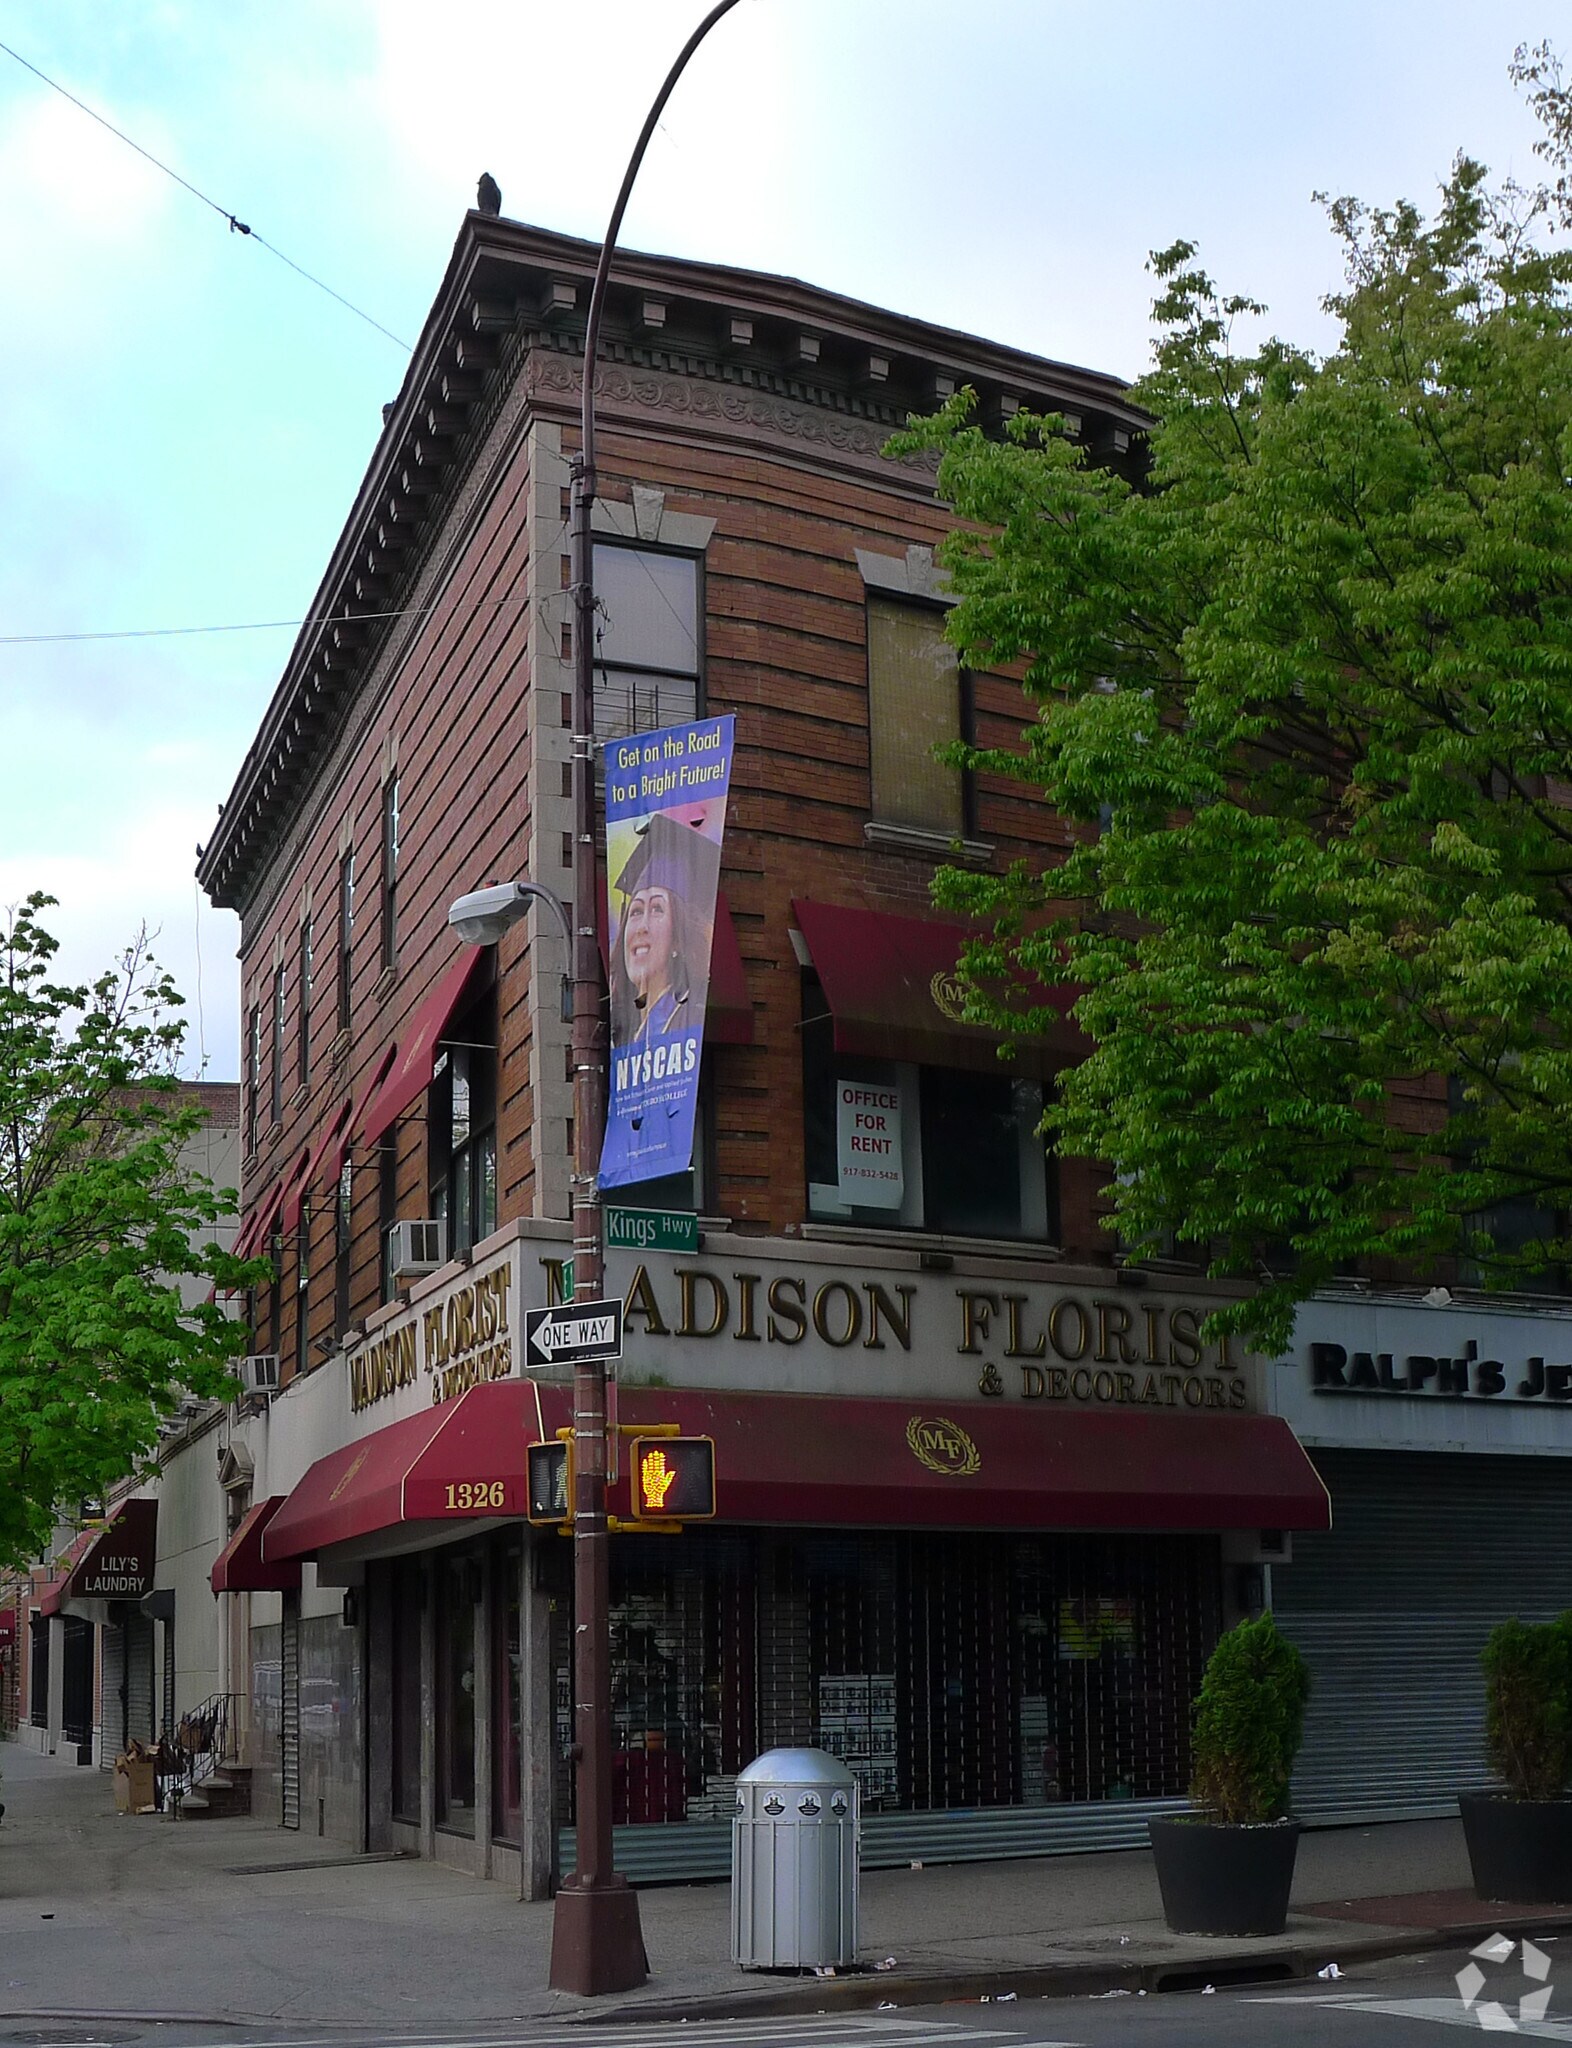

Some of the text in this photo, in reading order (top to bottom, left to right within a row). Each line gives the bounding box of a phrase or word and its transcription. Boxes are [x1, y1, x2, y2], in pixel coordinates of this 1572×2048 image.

[618, 725, 720, 769] Get on the Road
[612, 757, 725, 803] to a Bright Future!
[616, 1038, 697, 1092] NYSCAS
[842, 1088, 898, 1110] OFFICE
[855, 1113, 887, 1132] FOR
[851, 1136, 892, 1154] RENT
[608, 1211, 692, 1247] Kings Hwy
[350, 1261, 512, 1413] MADISON FLORIST
[543, 1319, 608, 1348] ONE WAY
[1310, 1340, 1506, 1395] RALPH'S
[978, 1363, 1247, 1410] & DECORATORS
[445, 1481, 505, 1509] 1326
[101, 1555, 139, 1572] LILY'S
[85, 1576, 146, 1592] LAUNDRY
